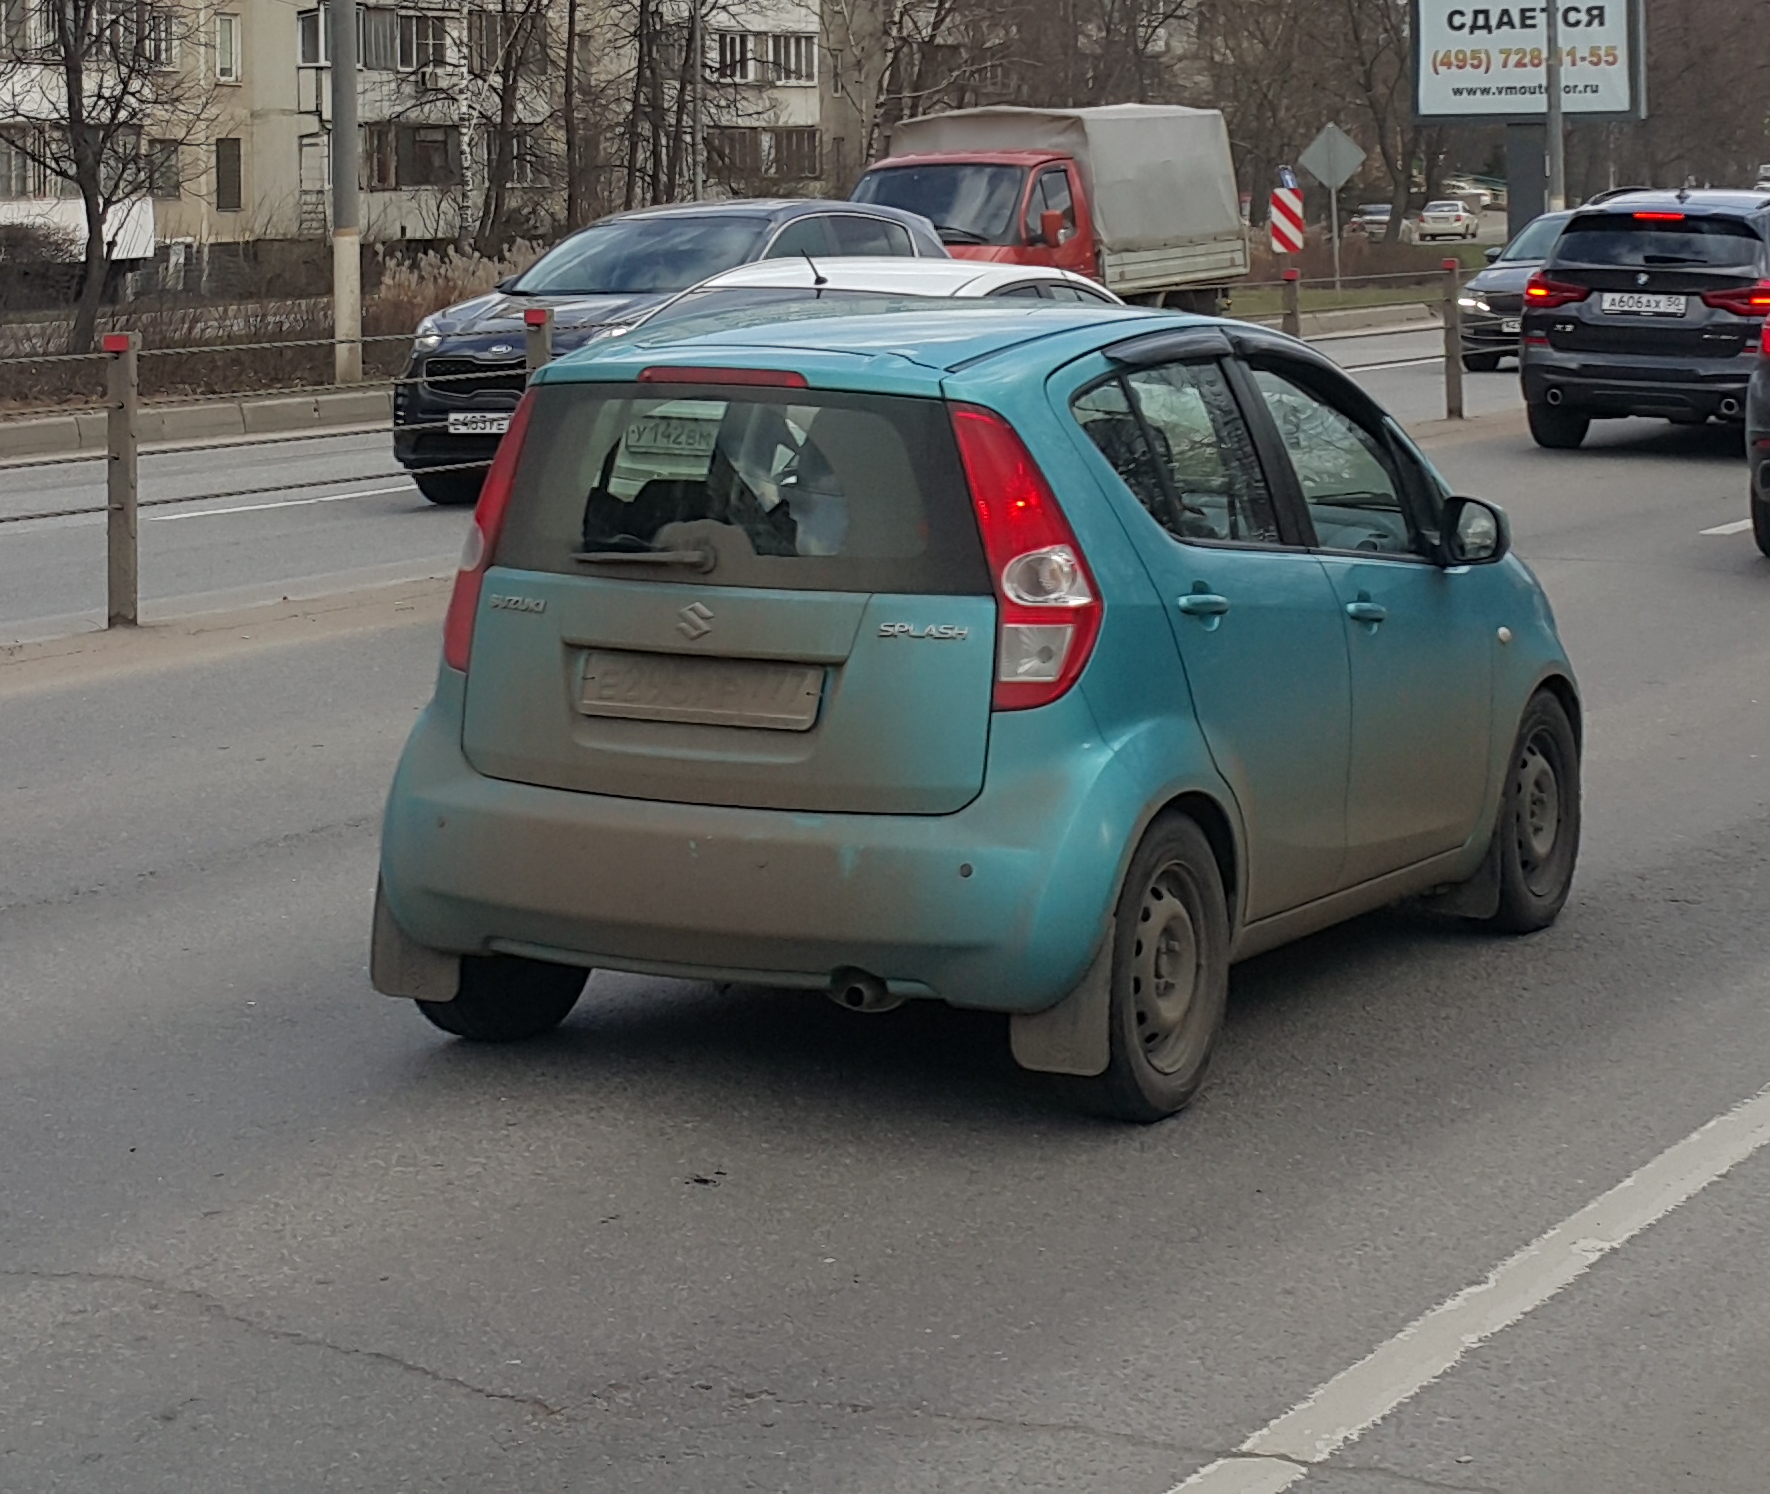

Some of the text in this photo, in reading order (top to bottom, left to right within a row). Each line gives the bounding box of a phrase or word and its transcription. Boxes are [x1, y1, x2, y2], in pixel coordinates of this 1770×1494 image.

[1432, 48, 1491, 76] (495)
[1451, 83, 1600, 97] www.vmoutor.ru
[878, 622, 969, 640] SPLASH
